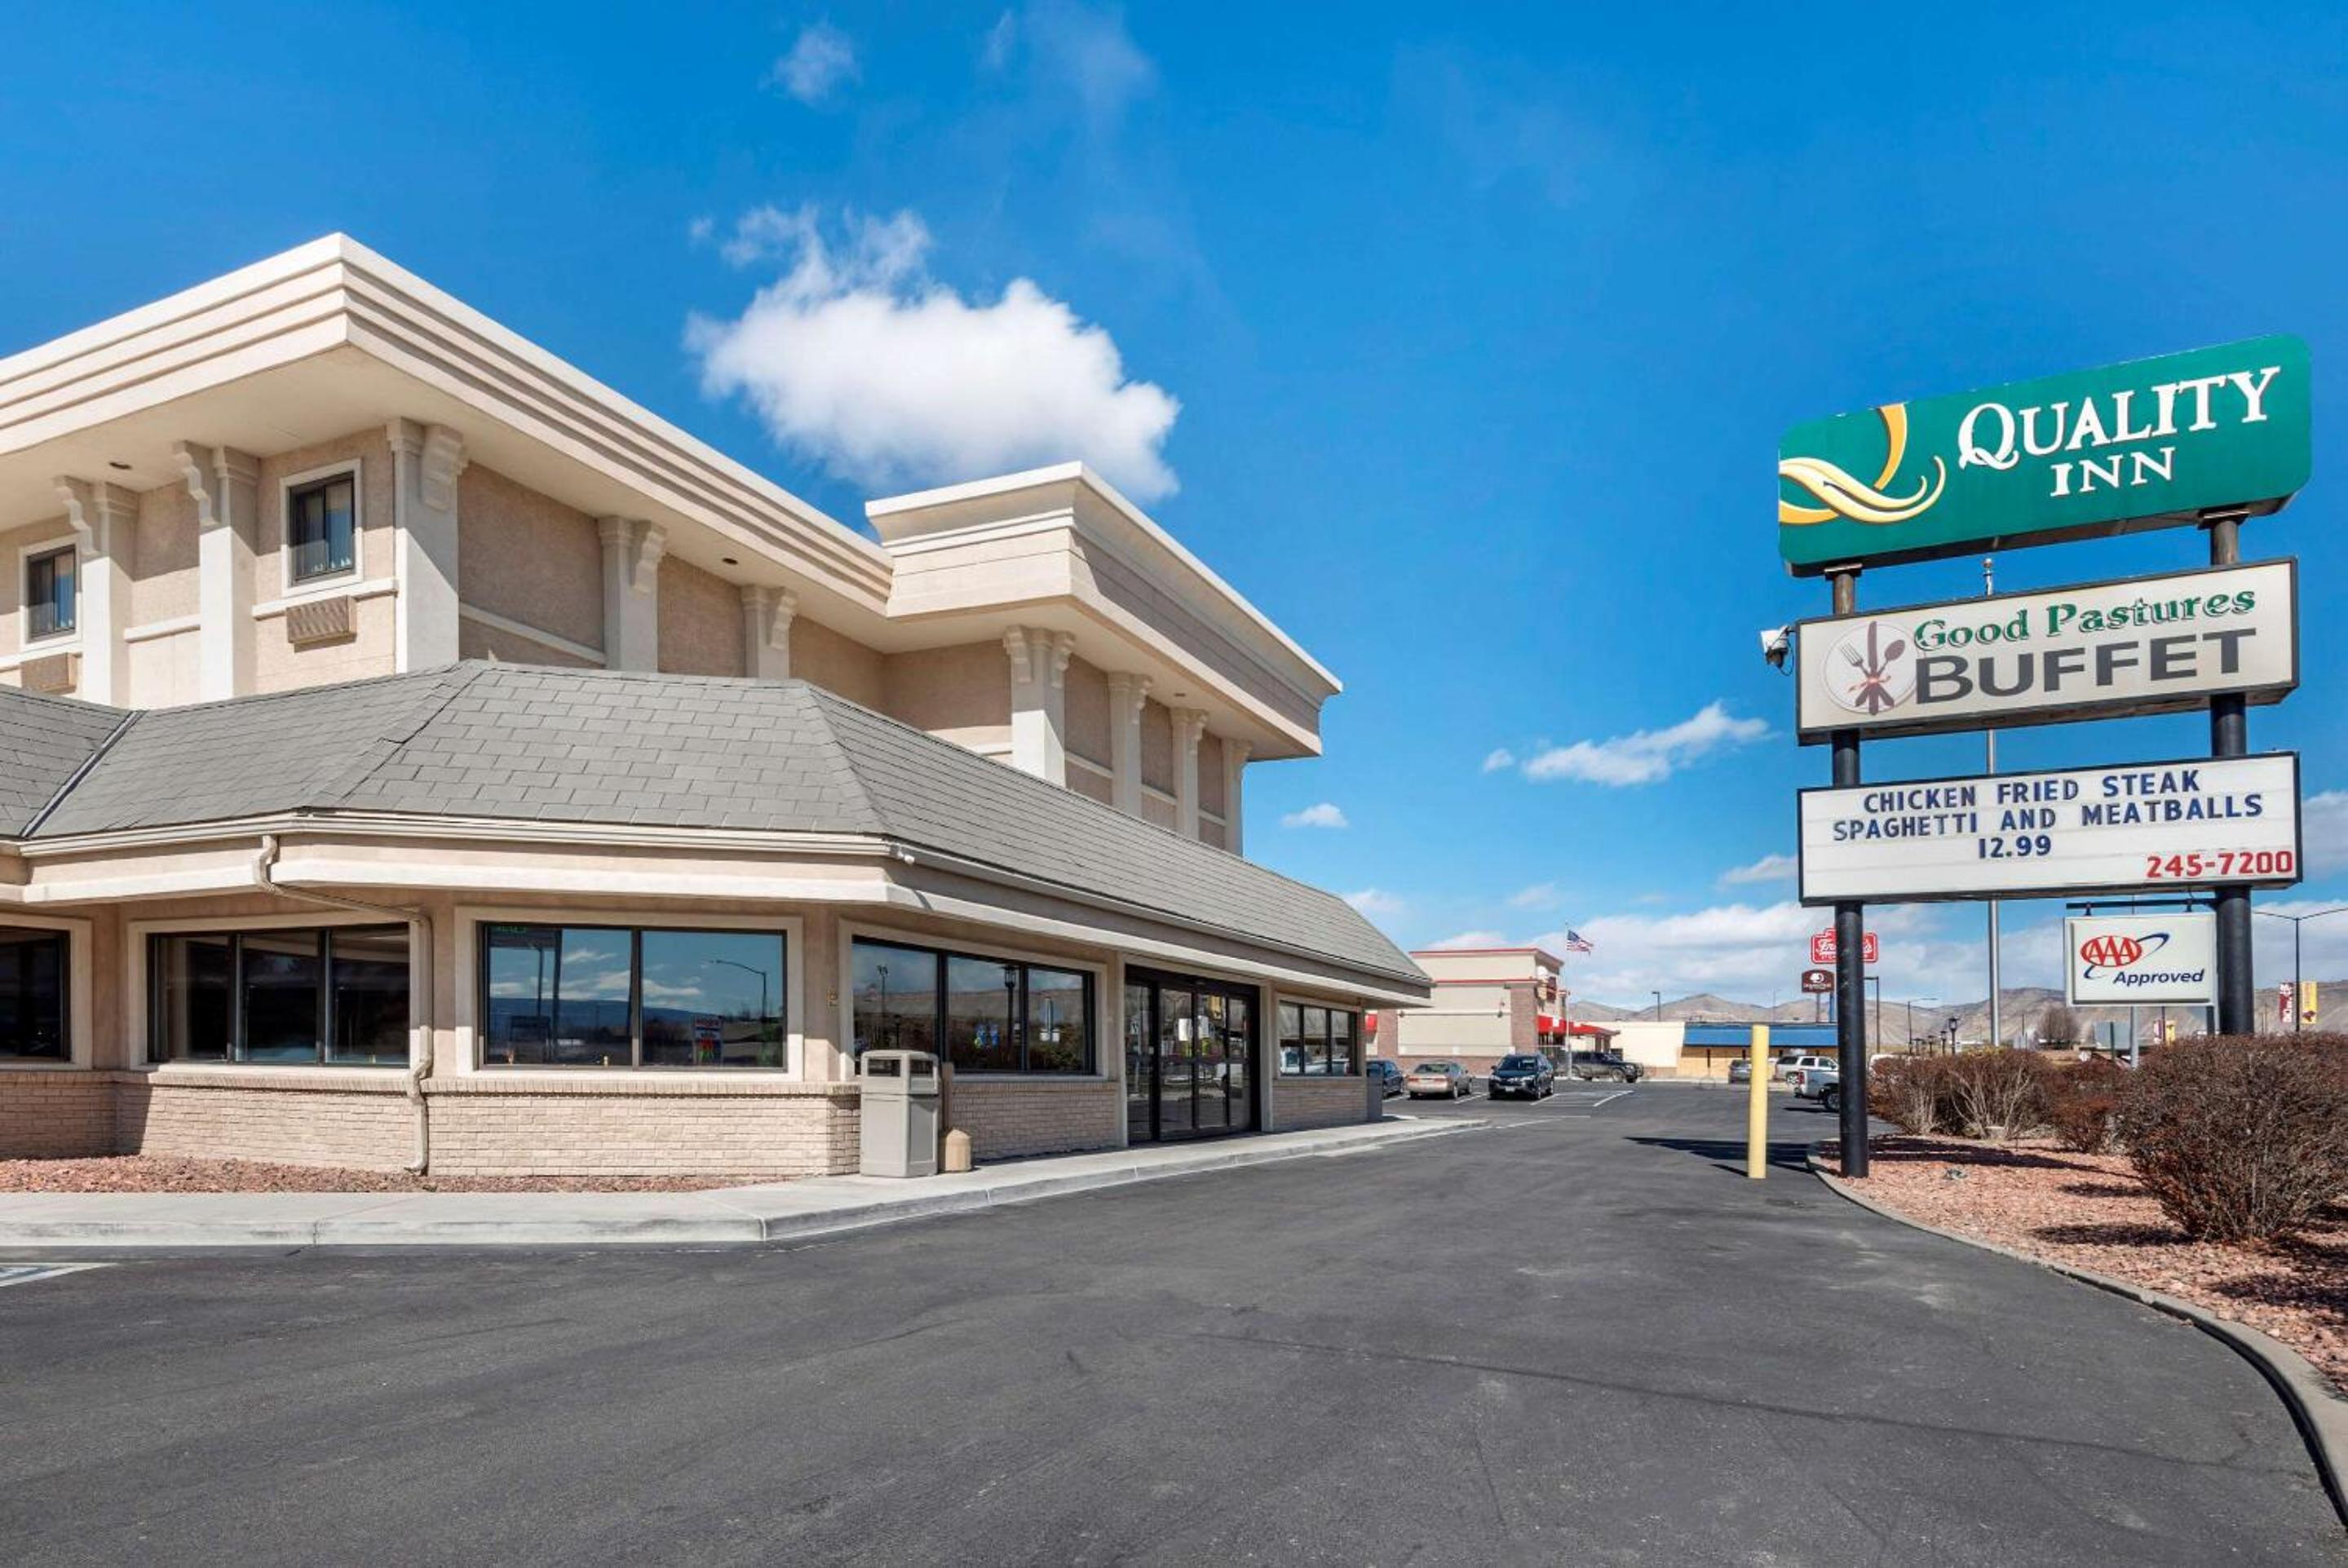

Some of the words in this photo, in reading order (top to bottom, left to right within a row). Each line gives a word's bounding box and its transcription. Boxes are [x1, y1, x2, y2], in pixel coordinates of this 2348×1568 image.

[1957, 366, 2281, 470] QUALITY
[2050, 447, 2176, 497] INN
[1914, 609, 2030, 651] Good
[2046, 590, 2257, 638] Pastures
[1915, 627, 2257, 704] BUFFET
[1863, 785, 1976, 814] CHICKEN
[1996, 780, 2079, 805] FRIED
[2102, 769, 2200, 797] STEAK
[1833, 812, 1977, 841] SPAGHETTI
[2001, 808, 2058, 831] AND
[2081, 794, 2263, 826] MEATBALLS
[1979, 835, 2051, 859] 12.99
[2147, 850, 2293, 878] 245-7200
[2088, 935, 2137, 966] AAA
[2112, 967, 2205, 987] Approved
